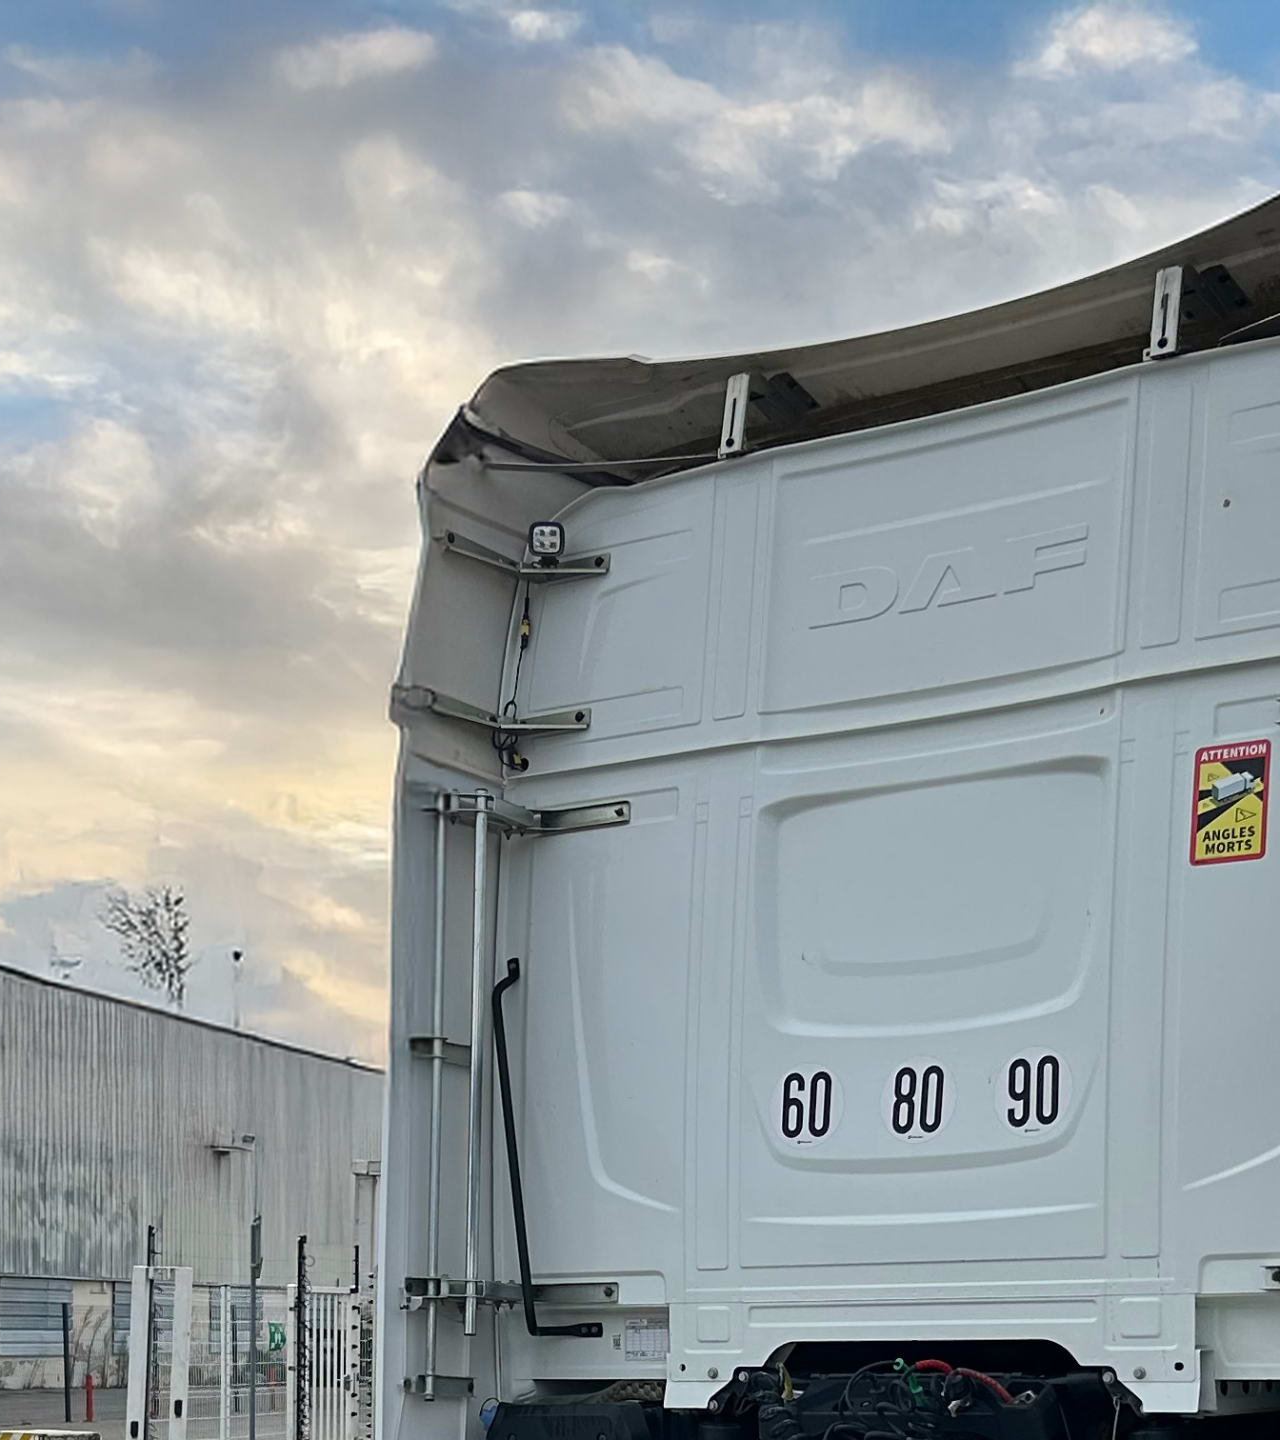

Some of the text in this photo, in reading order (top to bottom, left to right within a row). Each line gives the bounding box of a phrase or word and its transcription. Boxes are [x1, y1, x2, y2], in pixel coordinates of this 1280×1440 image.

[808, 522, 1089, 629] DAF
[1200, 743, 1267, 762] ATTENTION
[1202, 826, 1256, 842] ANGLES
[1205, 839, 1252, 855] MORTS
[781, 1055, 1059, 1138] 60 80 90
